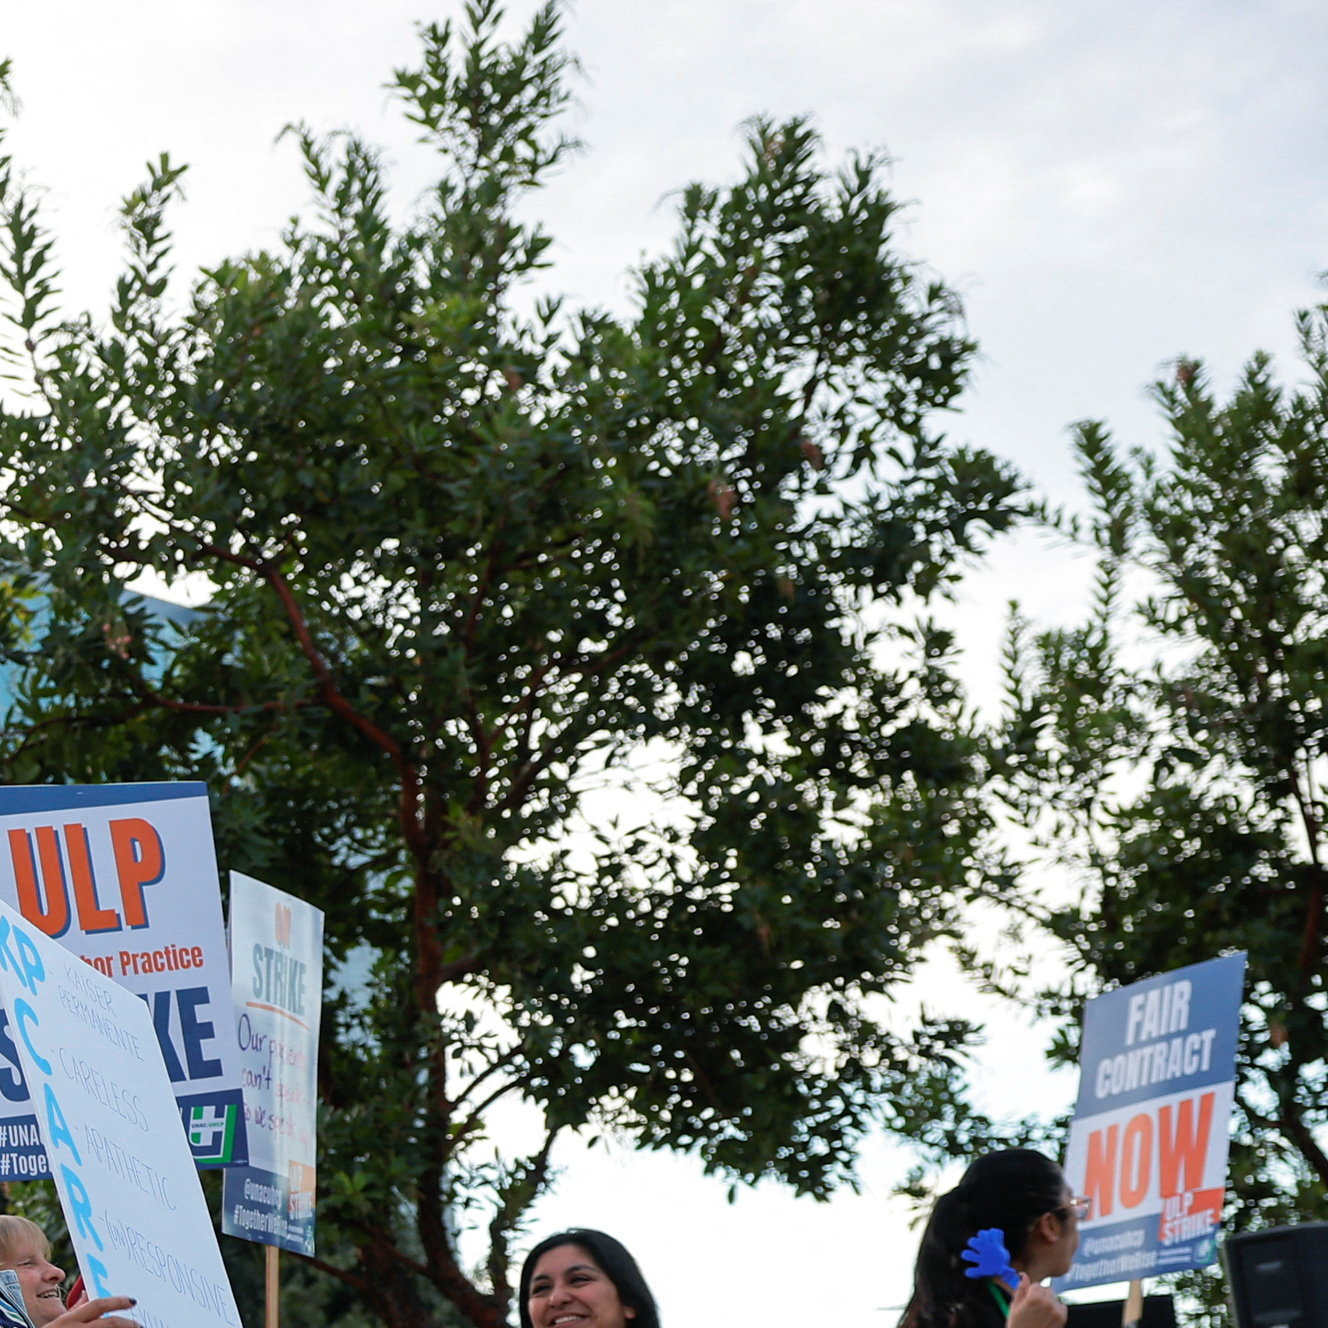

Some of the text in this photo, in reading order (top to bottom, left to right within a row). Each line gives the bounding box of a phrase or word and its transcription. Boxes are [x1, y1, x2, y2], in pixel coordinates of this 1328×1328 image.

[8, 818, 167, 939] ULP
[64, 963, 117, 1017] KAISER
[121, 946, 204, 976] Practice
[253, 943, 307, 1017] STRIKE
[58, 985, 144, 1062] PERMANENTE
[238, 1013, 267, 1052] Our
[1125, 980, 1192, 1045] FAIR
[1096, 1029, 1216, 1099] CONTRACT
[1085, 1092, 1216, 1220] NOW
[1162, 1208, 1214, 1246] STRIKE
